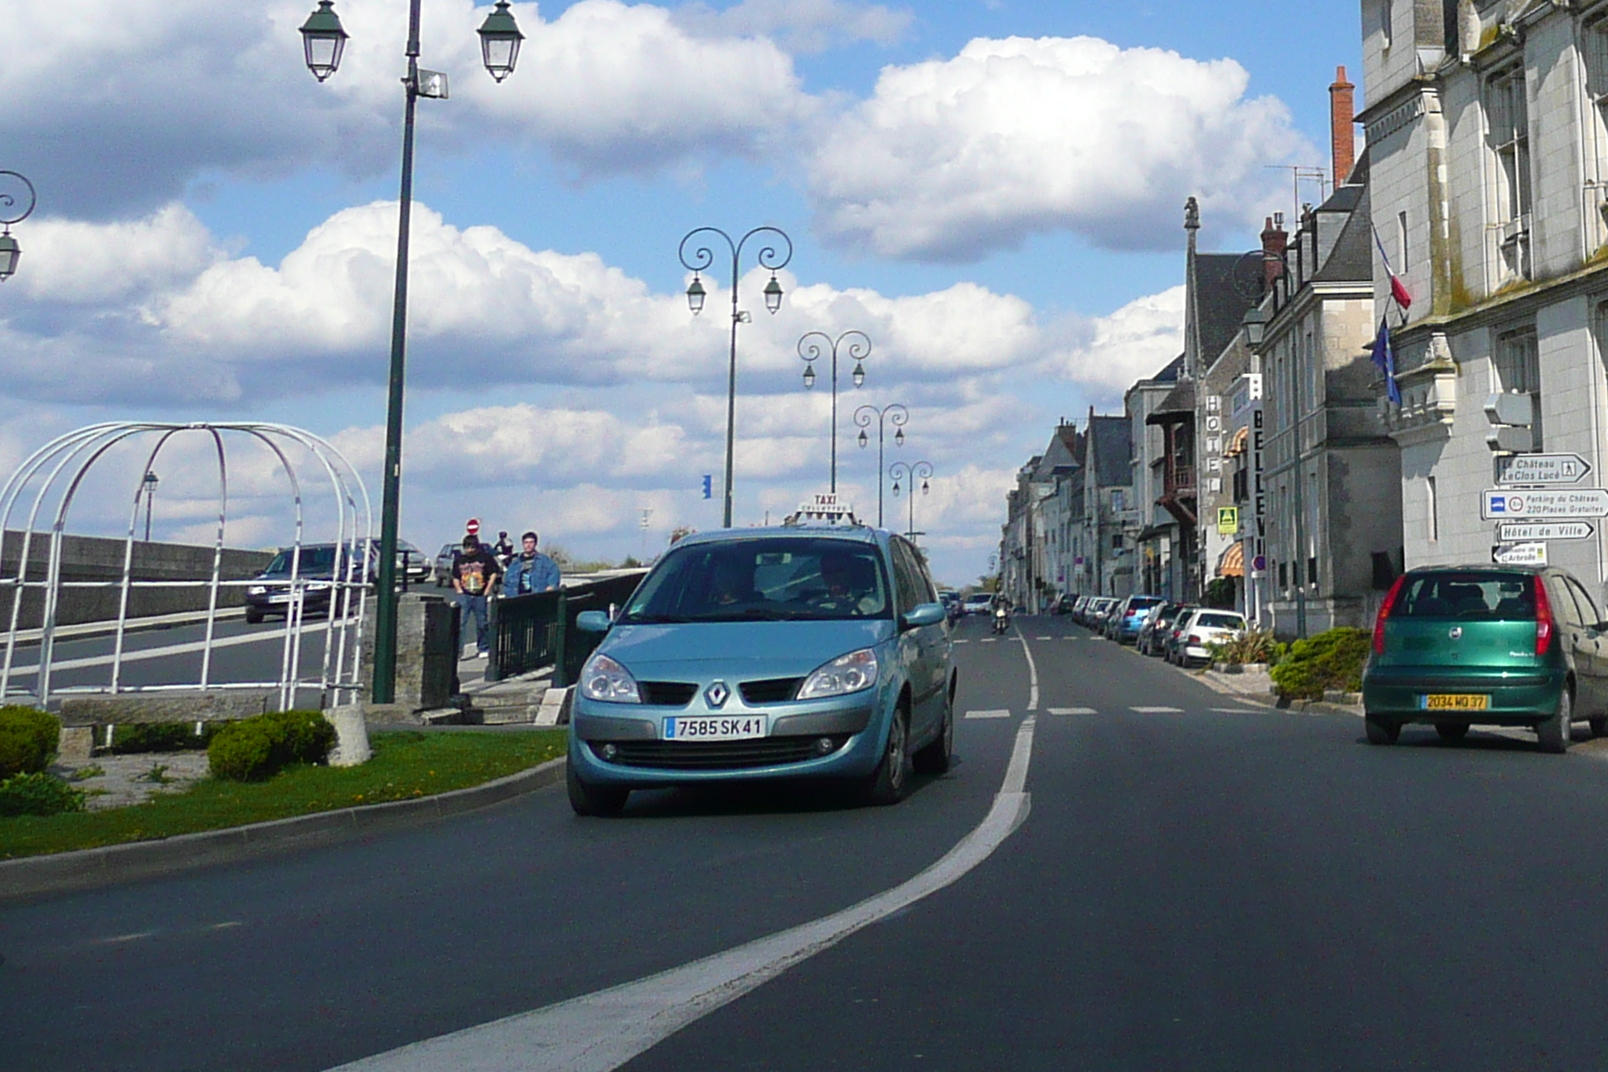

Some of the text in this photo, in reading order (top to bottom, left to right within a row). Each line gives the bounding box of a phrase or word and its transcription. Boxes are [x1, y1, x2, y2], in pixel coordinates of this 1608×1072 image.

[1207, 396, 1221, 494] HOTEL
[1502, 458, 1555, 469] Le Château
[1537, 467, 1561, 480] Lucé
[1254, 410, 1266, 556] BELLEVU
[815, 495, 837, 504] TAXI
[1526, 495, 1555, 505] Parking
[1557, 494, 1567, 503] du
[1568, 494, 1600, 503] Château
[1569, 504, 1604, 514] Gratuites
[1503, 525, 1583, 538] Hôtel de Ville
[1428, 696, 1453, 708] 2034
[1470, 696, 1484, 708] 37
[679, 719, 761, 736] 7585 SK 41
